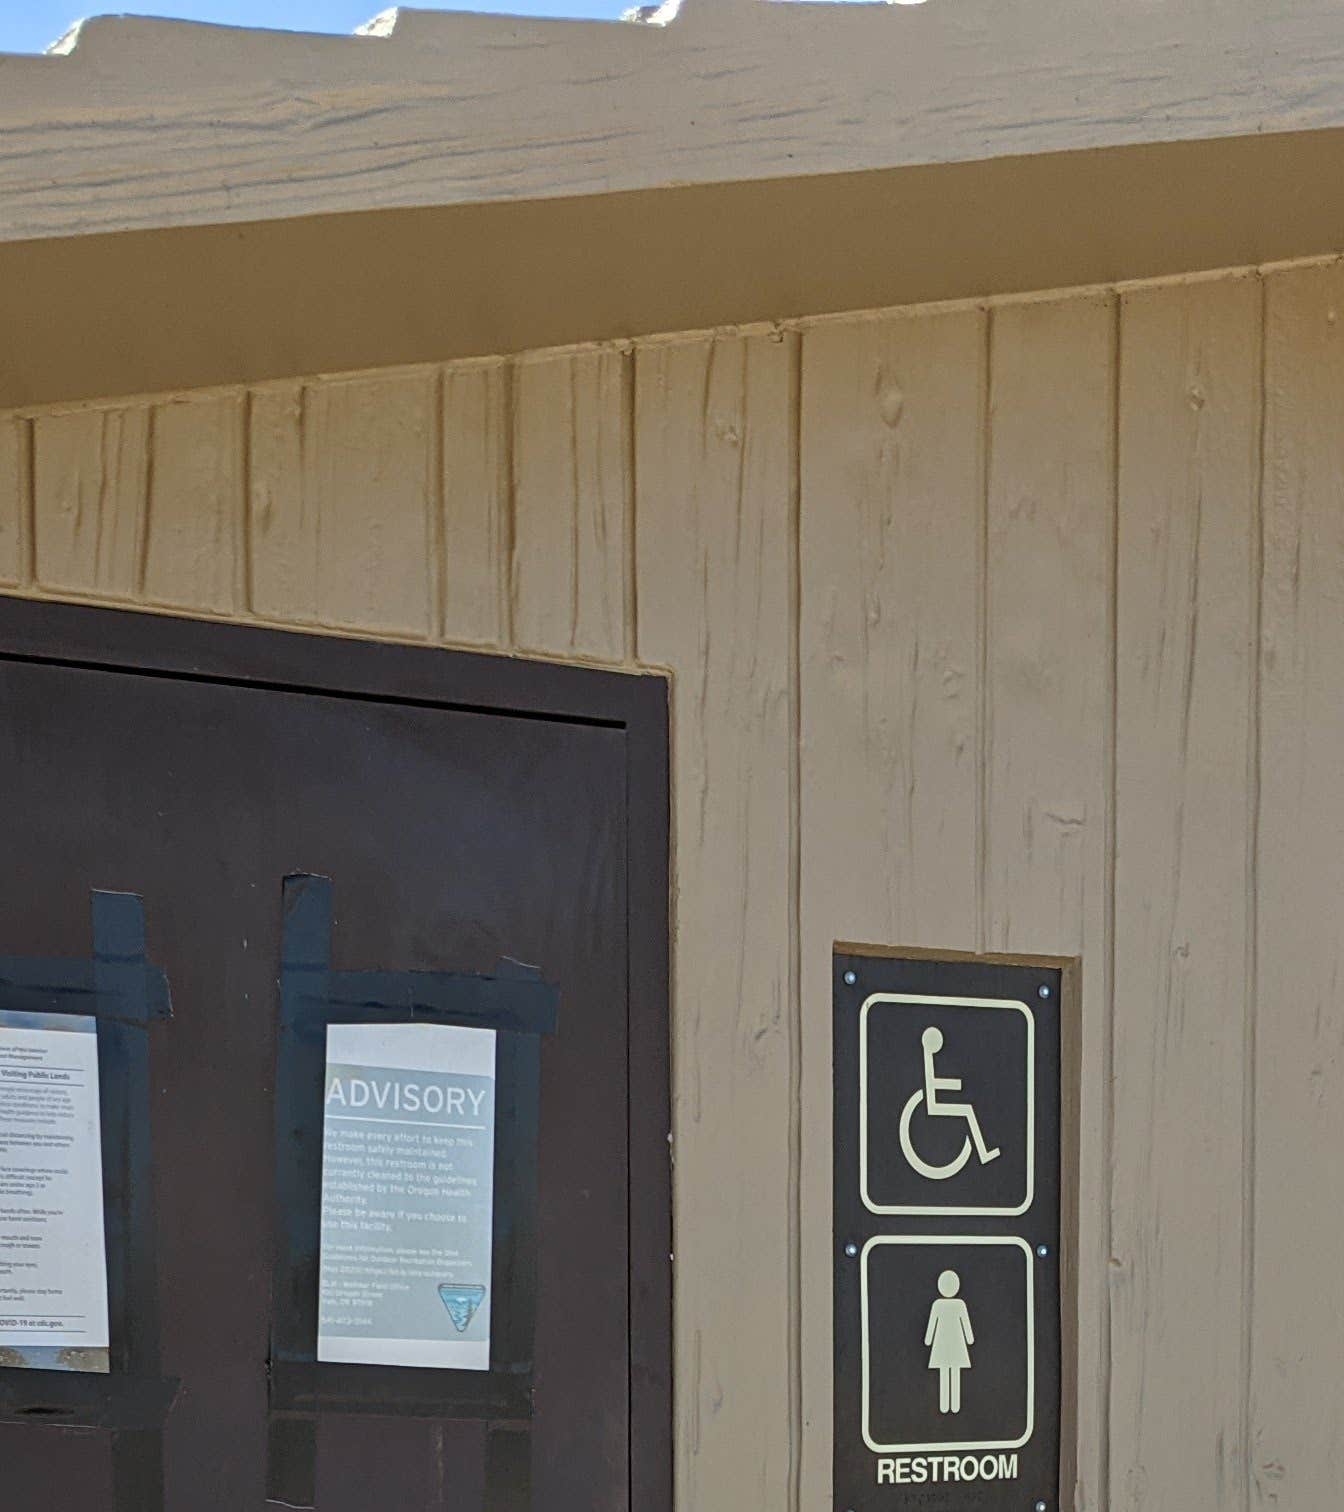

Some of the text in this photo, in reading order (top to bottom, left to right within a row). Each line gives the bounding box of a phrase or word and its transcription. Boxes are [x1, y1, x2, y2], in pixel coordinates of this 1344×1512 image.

[1, 1069, 27, 1079] Visiting
[28, 1071, 49, 1079] Public
[50, 1072, 70, 1080] Lands
[326, 1078, 485, 1116] ADVISORY
[877, 1453, 1018, 1484] RESTROOM
